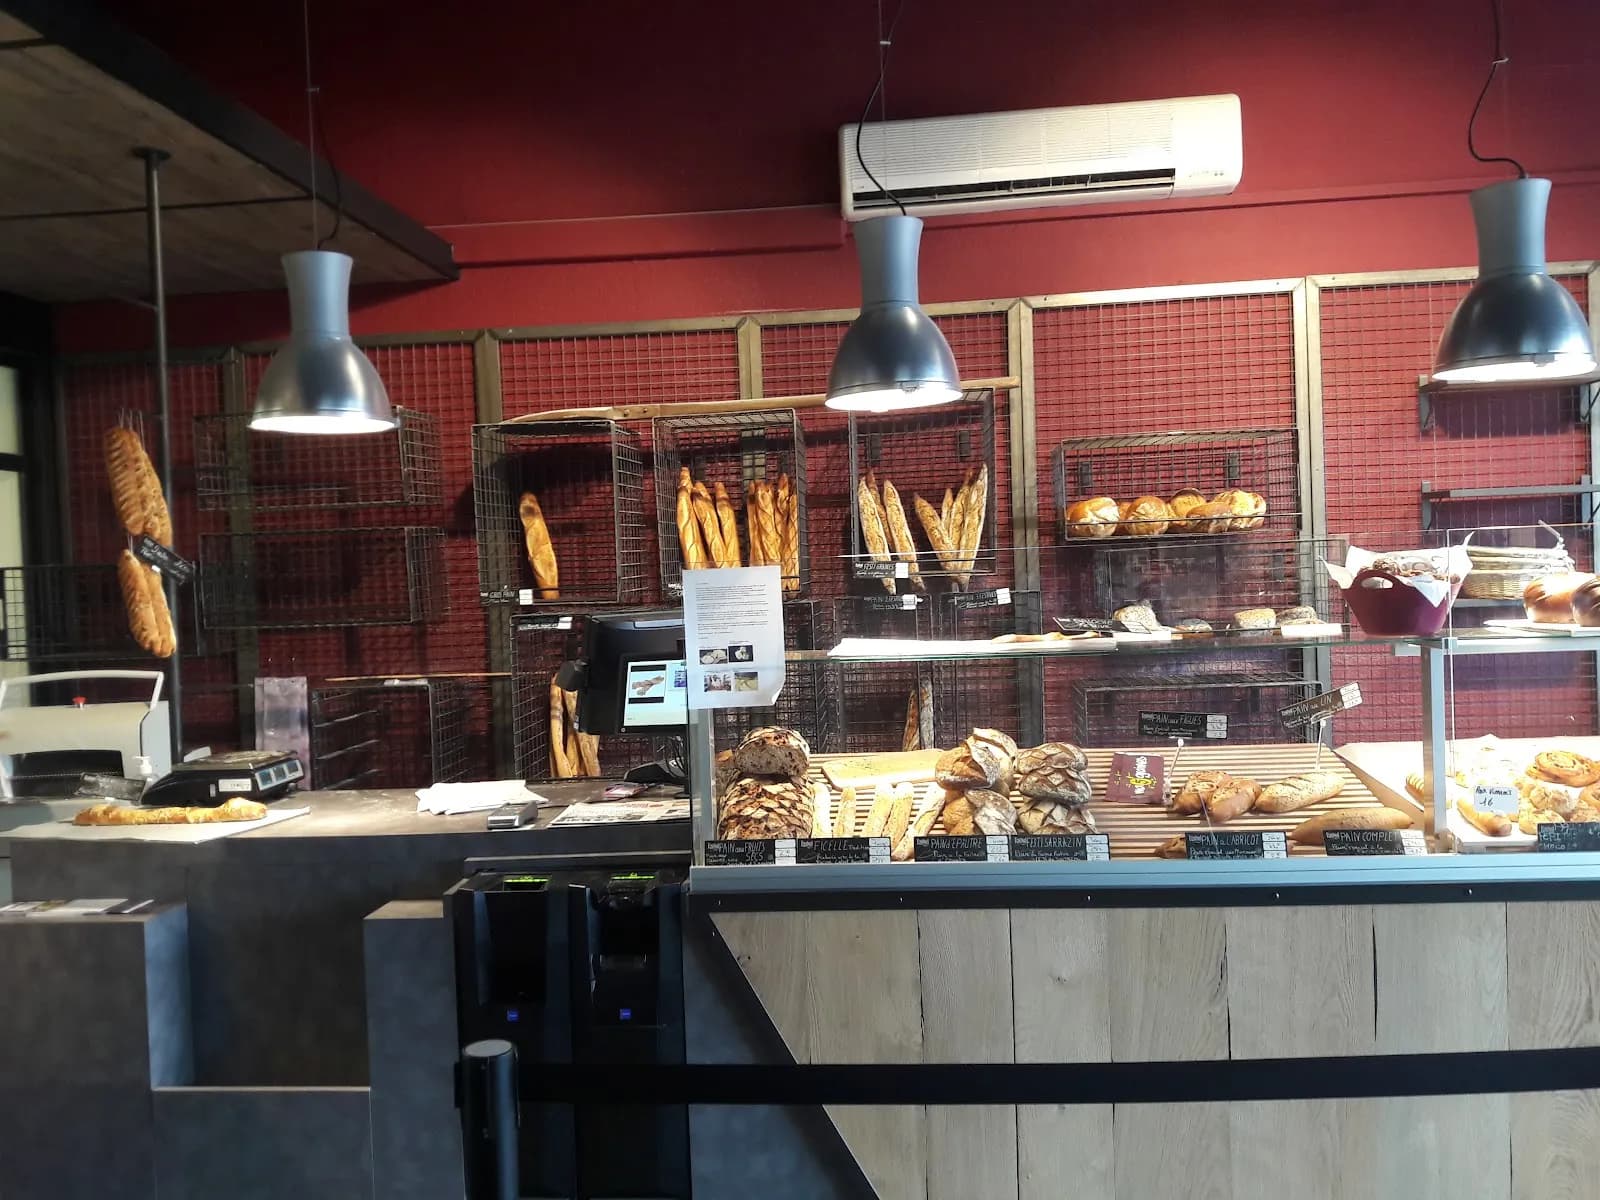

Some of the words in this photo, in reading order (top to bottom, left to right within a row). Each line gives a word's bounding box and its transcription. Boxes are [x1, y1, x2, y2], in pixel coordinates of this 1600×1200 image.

[1293, 703, 1309, 717] PAIN
[1321, 695, 1333, 706] LIN
[1201, 834, 1219, 845] PAIN
[1340, 831, 1360, 842] PAIN
[1362, 831, 1397, 842] COMPLET
[719, 841, 735, 853] PAIN
[744, 841, 766, 853] FRUITS
[814, 840, 848, 851] FICELLE
[745, 852, 764, 861] SECS
